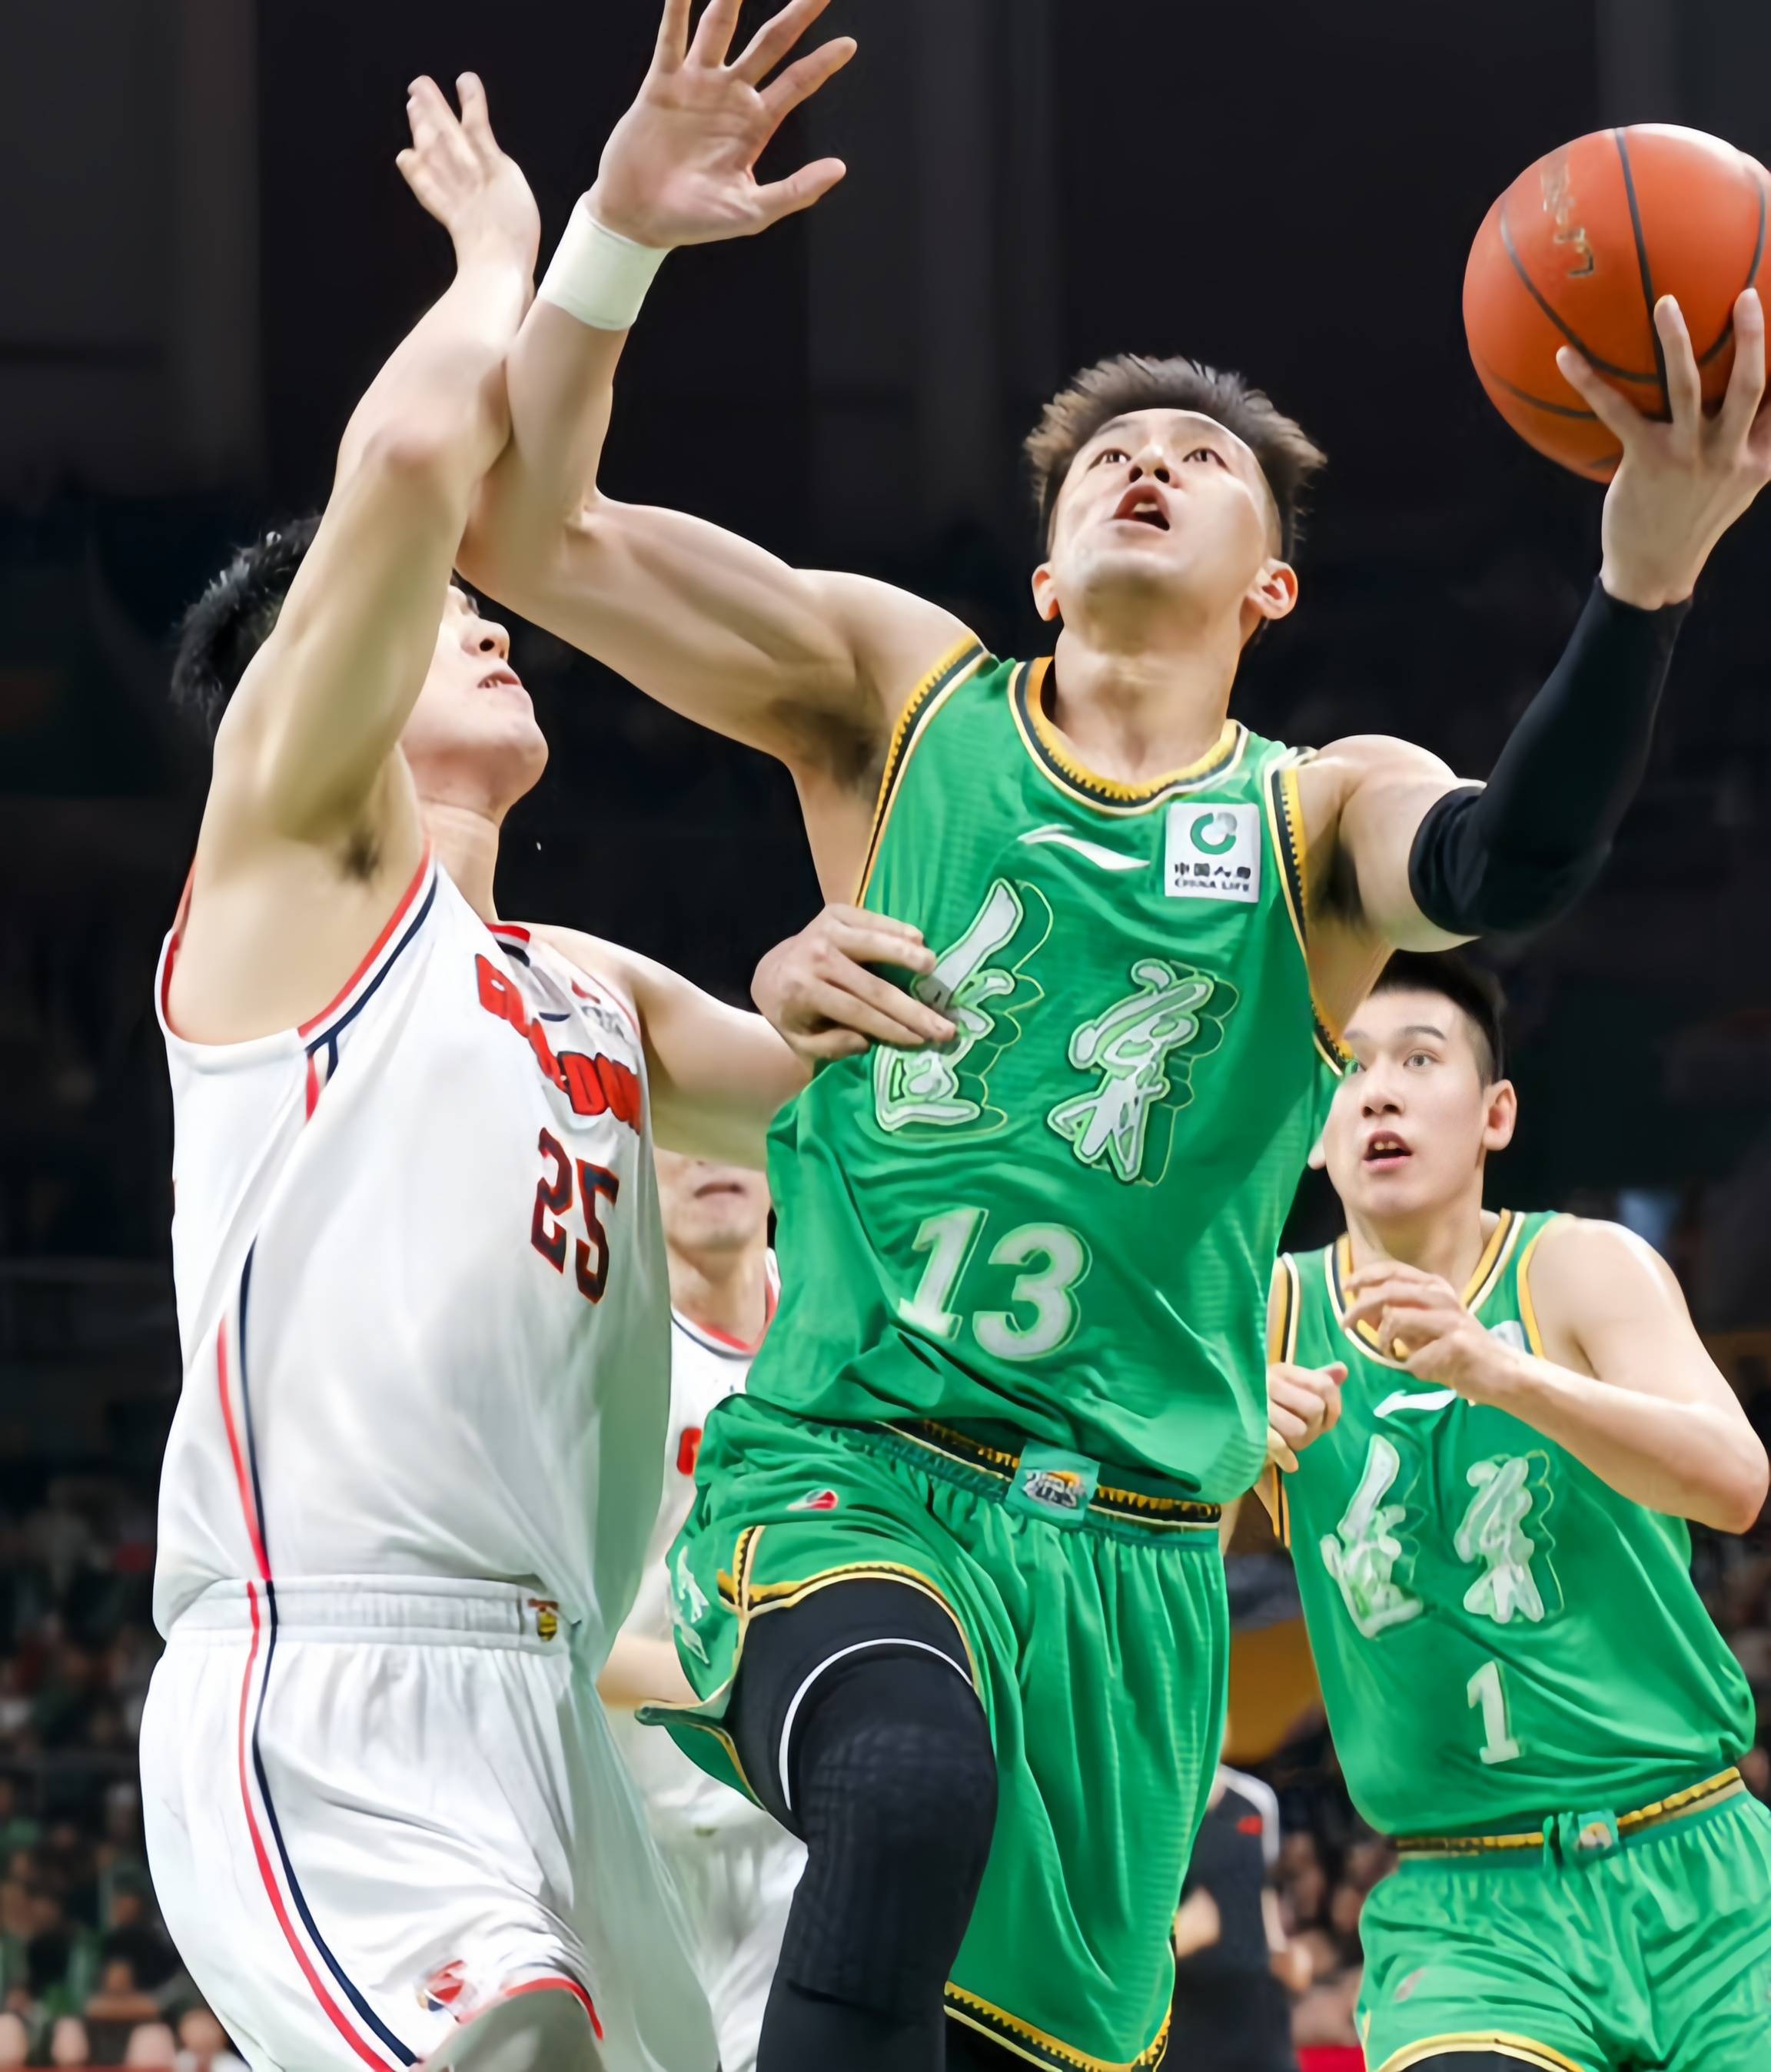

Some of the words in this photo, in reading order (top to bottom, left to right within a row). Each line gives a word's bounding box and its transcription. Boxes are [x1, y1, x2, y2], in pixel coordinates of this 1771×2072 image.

[531, 1127, 620, 1304] 25
[897, 1202, 1093, 1362] 13
[1467, 1660, 1522, 1765] 1
